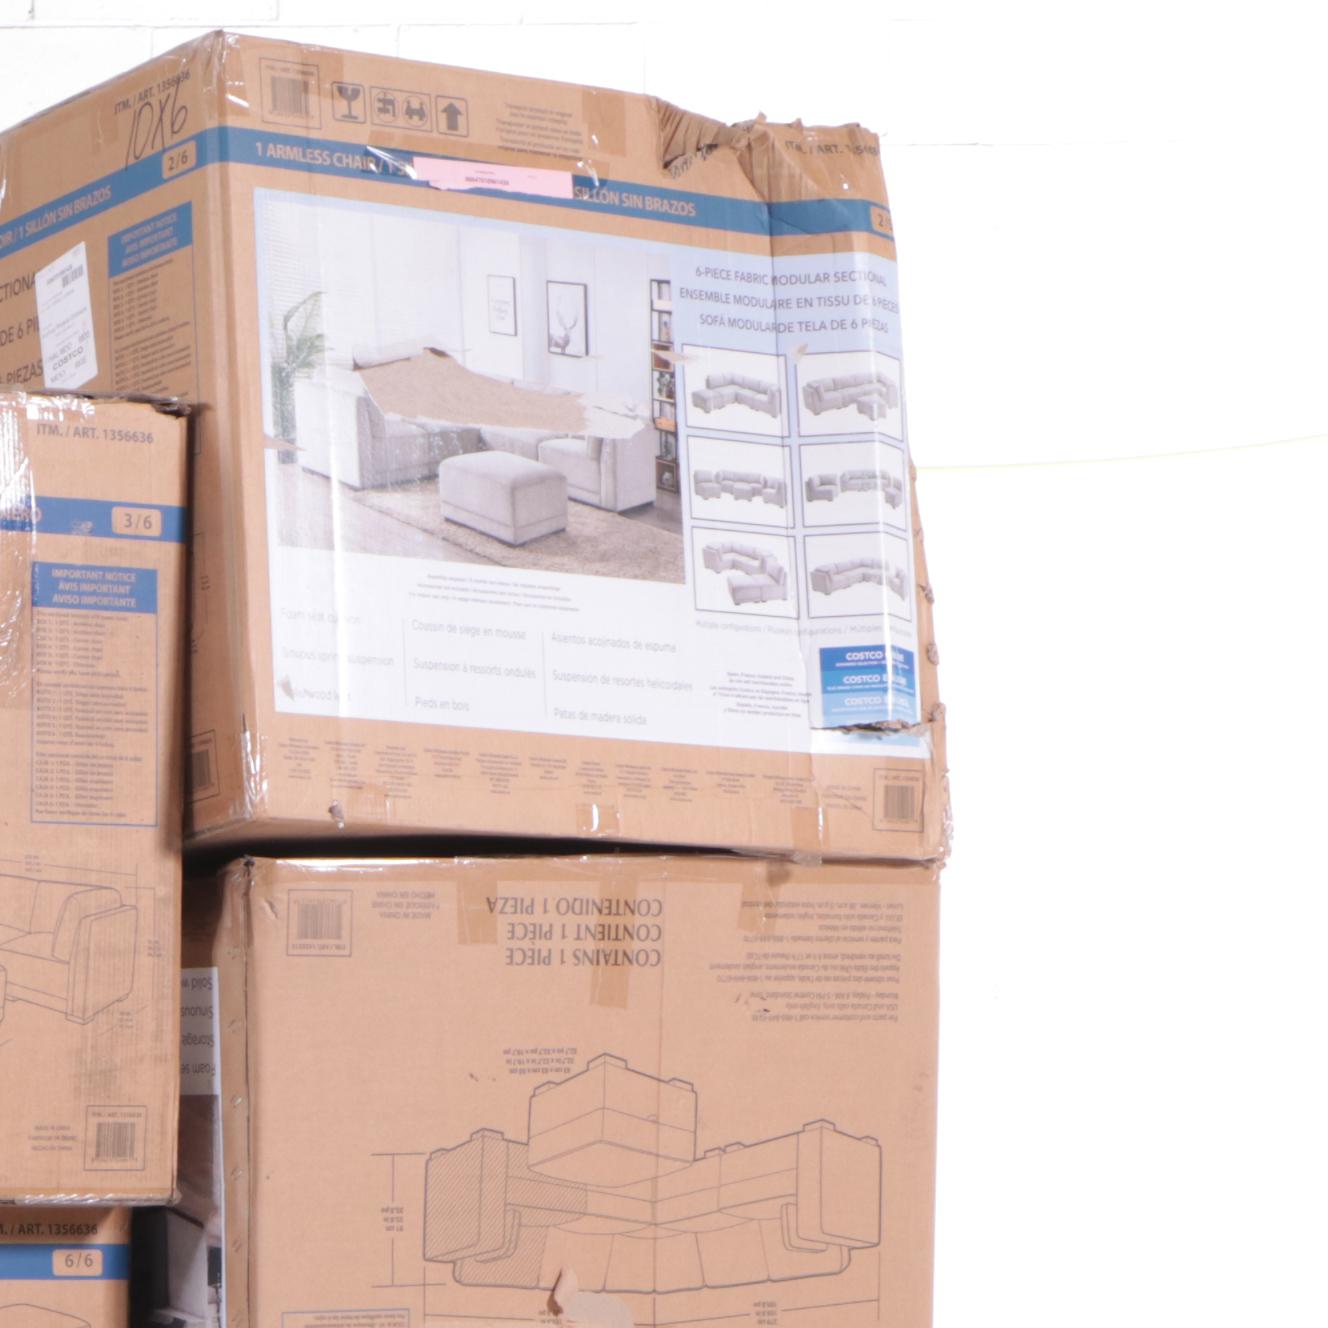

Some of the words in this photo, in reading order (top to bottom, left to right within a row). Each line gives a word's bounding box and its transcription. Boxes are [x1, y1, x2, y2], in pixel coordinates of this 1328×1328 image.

[168, 150, 188, 171] 2/6
[266, 143, 330, 165] ARMLESS
[621, 192, 642, 209] SIN
[645, 196, 696, 217] BRAZOS
[695, 267, 731, 281] 6-PIECE
[734, 270, 768, 285] FABRIC
[680, 288, 730, 304] ENSEMBLE
[796, 296, 814, 308] EN
[818, 295, 849, 308] TISSU
[777, 321, 794, 333] DE
[798, 320, 826, 332] TELA
[831, 318, 847, 330] DE
[52, 346, 83, 369] COSTCO
[36, 423, 62, 436] ITM.
[73, 426, 98, 439] ART.
[103, 429, 153, 443] 1356636
[124, 513, 152, 529] 3/6
[51, 568, 102, 579] IMPORTANT
[105, 572, 136, 582] NOTICE
[846, 651, 883, 661] COSTCO
[843, 675, 880, 685] COSTCO
[486, 897, 534, 914] PIEZA
[555, 898, 662, 916] CONTENIDO
[507, 922, 552, 944] PIÈCE
[574, 923, 661, 941] CONTIENT
[505, 948, 551, 965] PIECE
[572, 949, 661, 966] CONTAINS
[17, 1223, 43, 1234] ART.
[48, 1223, 97, 1235] 1356636
[65, 1254, 93, 1267] 6/6
